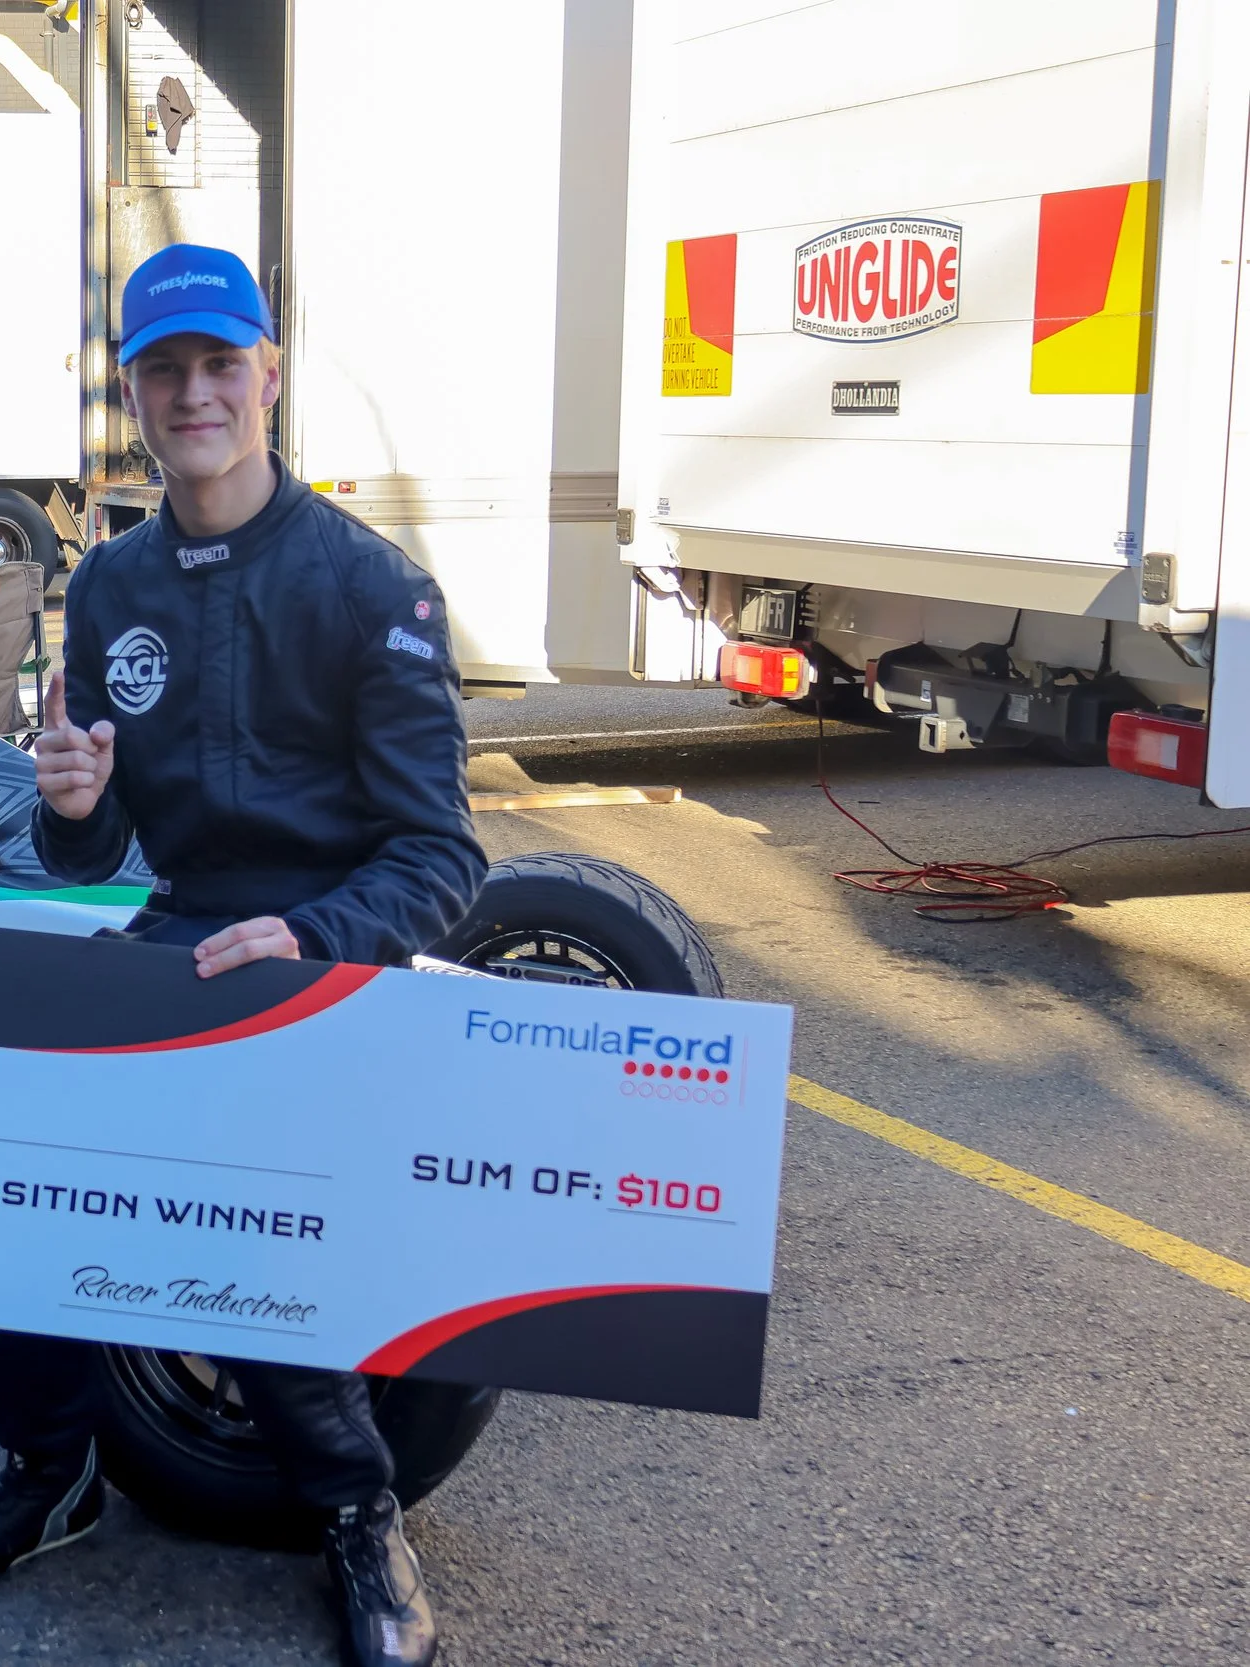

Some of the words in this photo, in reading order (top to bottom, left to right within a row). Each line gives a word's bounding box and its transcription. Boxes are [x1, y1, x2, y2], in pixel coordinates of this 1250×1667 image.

[798, 235, 838, 261] FRICTION
[840, 224, 887, 242] REDUCING
[890, 222, 959, 242] CONCENTRATE
[797, 239, 958, 324] UNIGLIDE
[664, 317, 673, 337] DO
[674, 317, 687, 337] NOT
[796, 318, 859, 337] PERFORMANCE
[861, 326, 888, 337] FROM
[890, 302, 956, 333] TECHNOLOGY
[662, 343, 696, 363] OVERTAKE
[662, 368, 690, 389] TURNING
[690, 368, 719, 389] VEHICLE
[832, 388, 899, 407] DHOLLANDIA
[387, 626, 434, 660] freem
[105, 656, 167, 685] ACL
[412, 1153, 513, 1190] SUM
[532, 1167, 603, 1201] OF:
[617, 1172, 722, 1213] $100
[154, 1198, 325, 1241] WINNER
[71, 1265, 159, 1303] Racer
[165, 1278, 319, 1324] Industries
